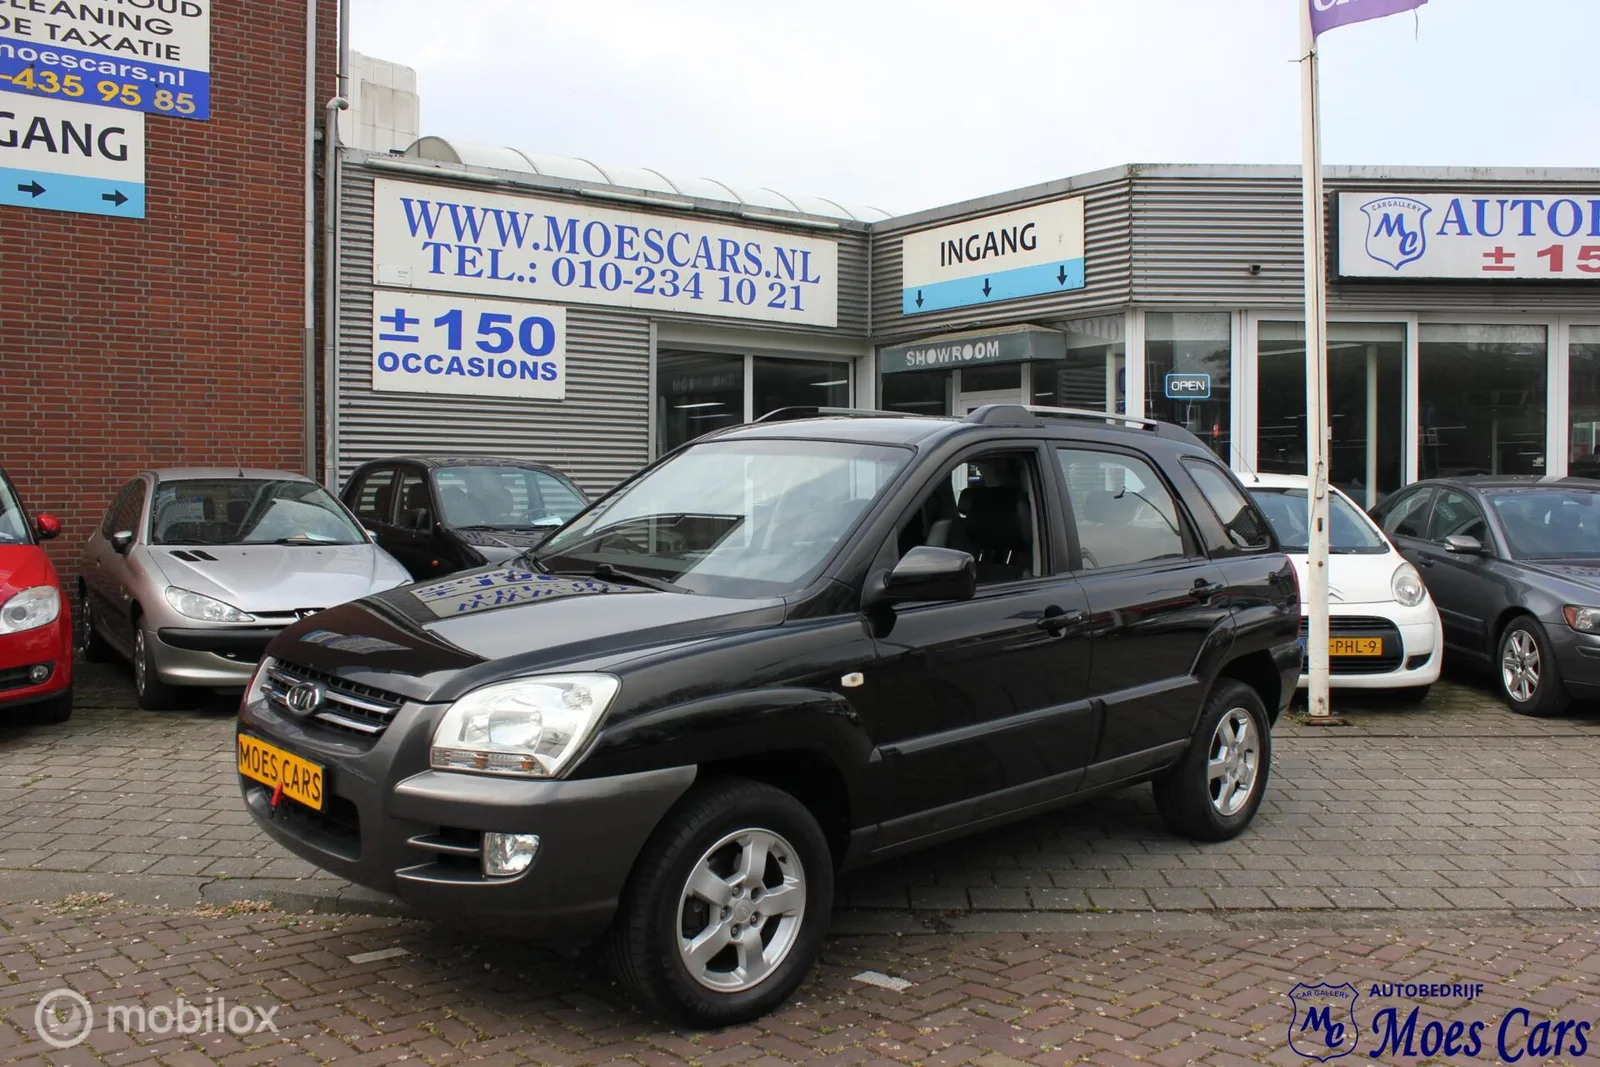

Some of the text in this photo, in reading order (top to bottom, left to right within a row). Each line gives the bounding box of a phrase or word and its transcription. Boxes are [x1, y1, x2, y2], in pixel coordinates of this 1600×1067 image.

[0, 0, 173, 36] LEANING
[44, 22, 181, 62] TAXATIE
[97, 80, 142, 106] 95
[153, 89, 196, 114] 85
[399, 197, 821, 285] WWW.MOESCARS.NL
[940, 222, 1037, 267] INGANG
[421, 241, 806, 311] TEL.: 010-234 10 21
[377, 351, 557, 381] OCCASIONS
[905, 340, 999, 367] SHOWROOM
[1171, 380, 1205, 392] OPEN
[239, 741, 321, 801] MOES CARS
